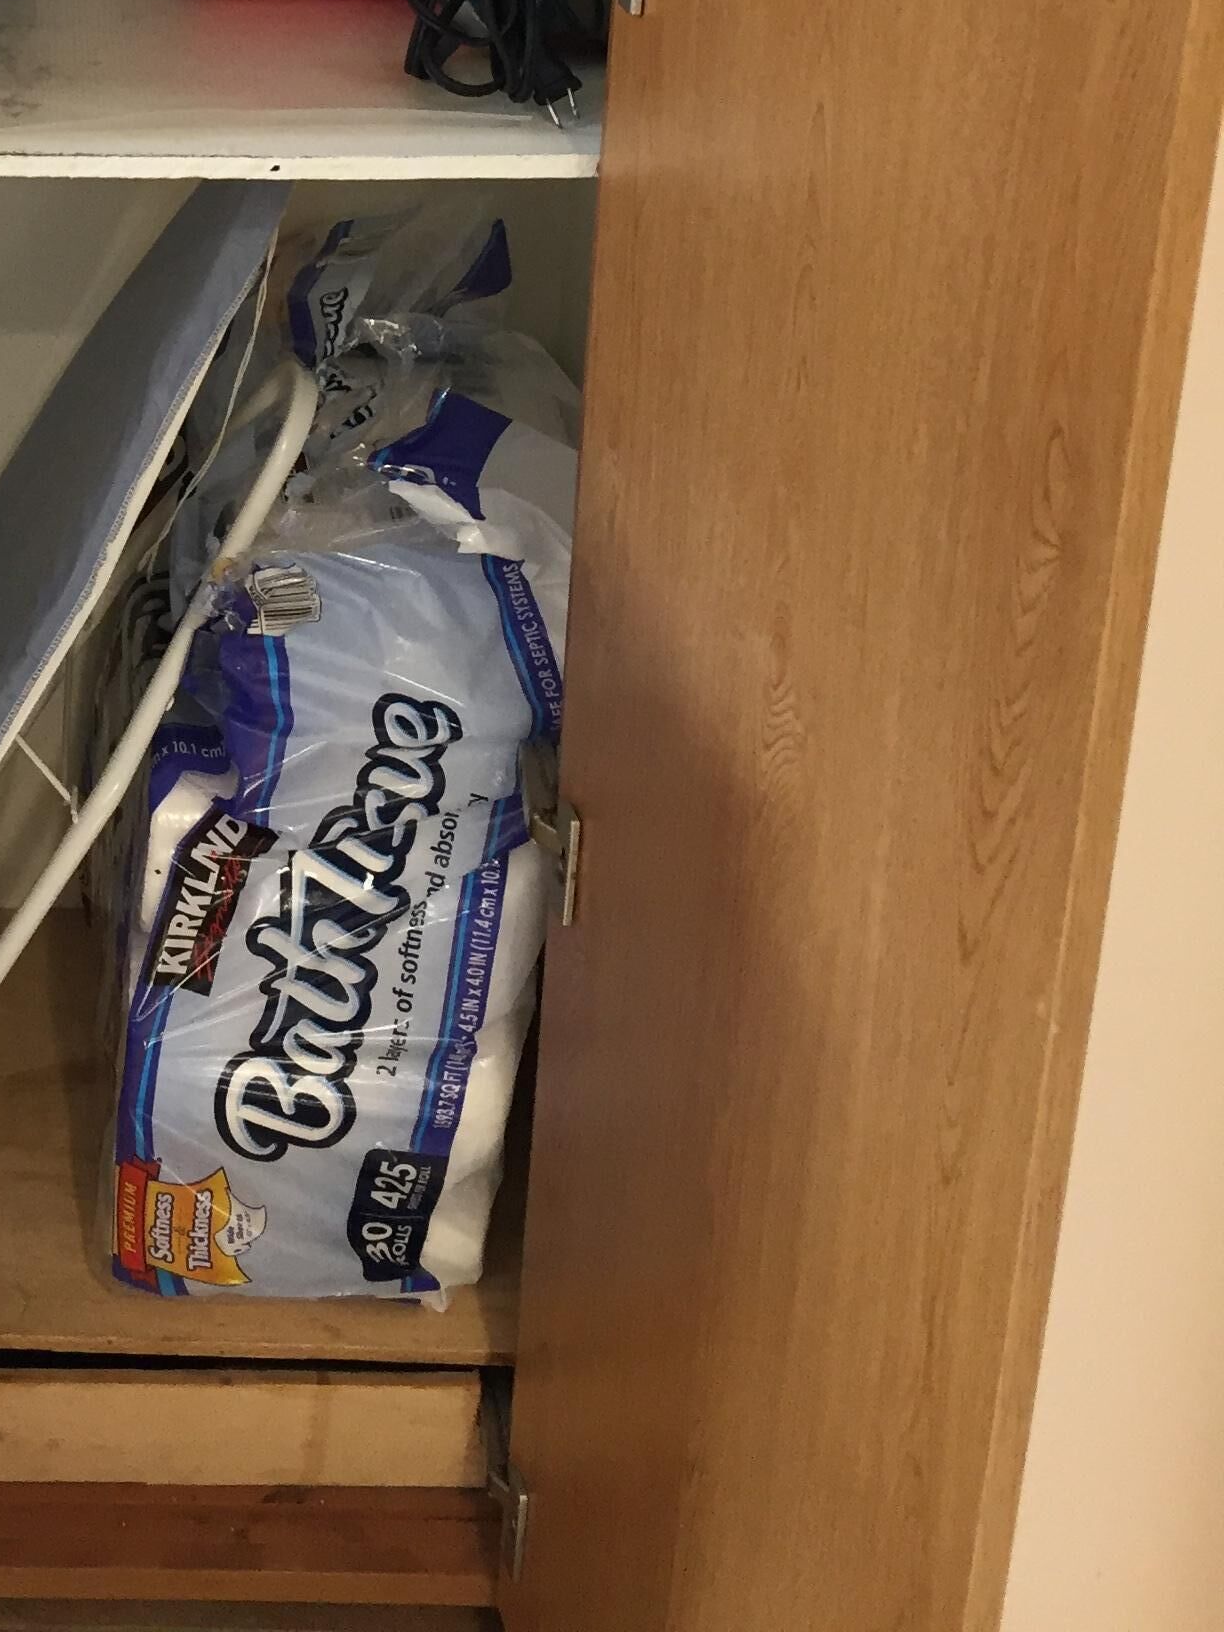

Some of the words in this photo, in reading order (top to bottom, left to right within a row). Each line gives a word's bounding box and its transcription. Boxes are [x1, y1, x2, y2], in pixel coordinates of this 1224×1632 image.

[502, 562, 534, 621] SYSTEMS
[521, 620, 549, 667] SEPTIC
[538, 668, 560, 699] FOR
[172, 740, 197, 755] 10.1
[424, 870, 446, 899] nd
[479, 898, 495, 918] cm
[397, 899, 427, 985] softness
[471, 918, 494, 951] (11.4
[468, 952, 487, 969] IN
[465, 969, 485, 988] 4.0
[392, 986, 414, 1014] of
[461, 998, 480, 1012] IN
[218, 914, 376, 1159] Bath
[458, 1011, 478, 1038] 4.5
[376, 1058, 396, 1078] 2
[370, 1160, 418, 1209] 425
[123, 1181, 138, 1255] PREMIUM
[151, 1192, 174, 1262] Softness
[188, 1189, 213, 1270] Thickness
[361, 1221, 397, 1264] 30
[392, 1224, 413, 1266] ROLLS
